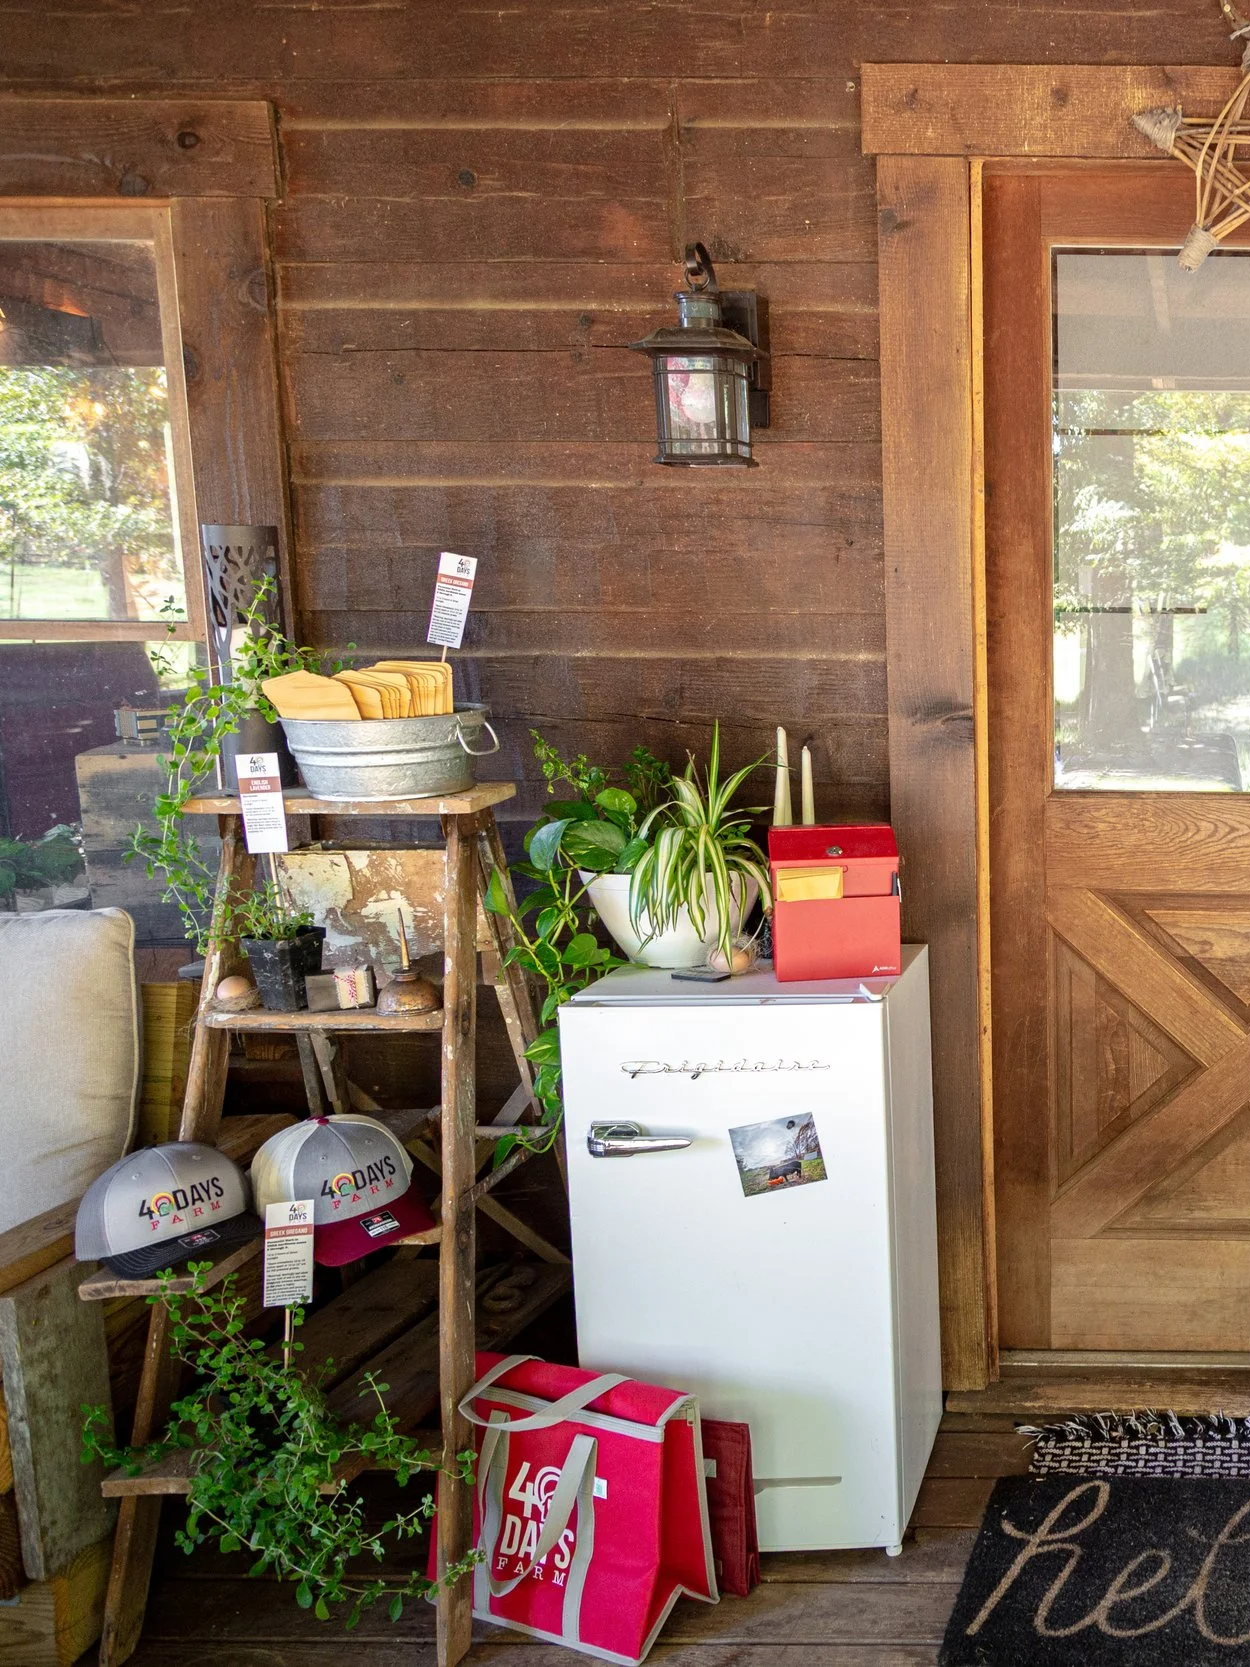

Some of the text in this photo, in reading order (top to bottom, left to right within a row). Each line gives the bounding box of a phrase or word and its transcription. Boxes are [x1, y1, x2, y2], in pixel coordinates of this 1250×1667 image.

[620, 1059, 830, 1080] Frigidaire
[351, 1155, 396, 1190] DAYS
[172, 1177, 224, 1211] DAYS
[332, 1178, 394, 1210] FARM
[150, 1200, 223, 1232] FARM
[288, 1213, 307, 1221] DAYS
